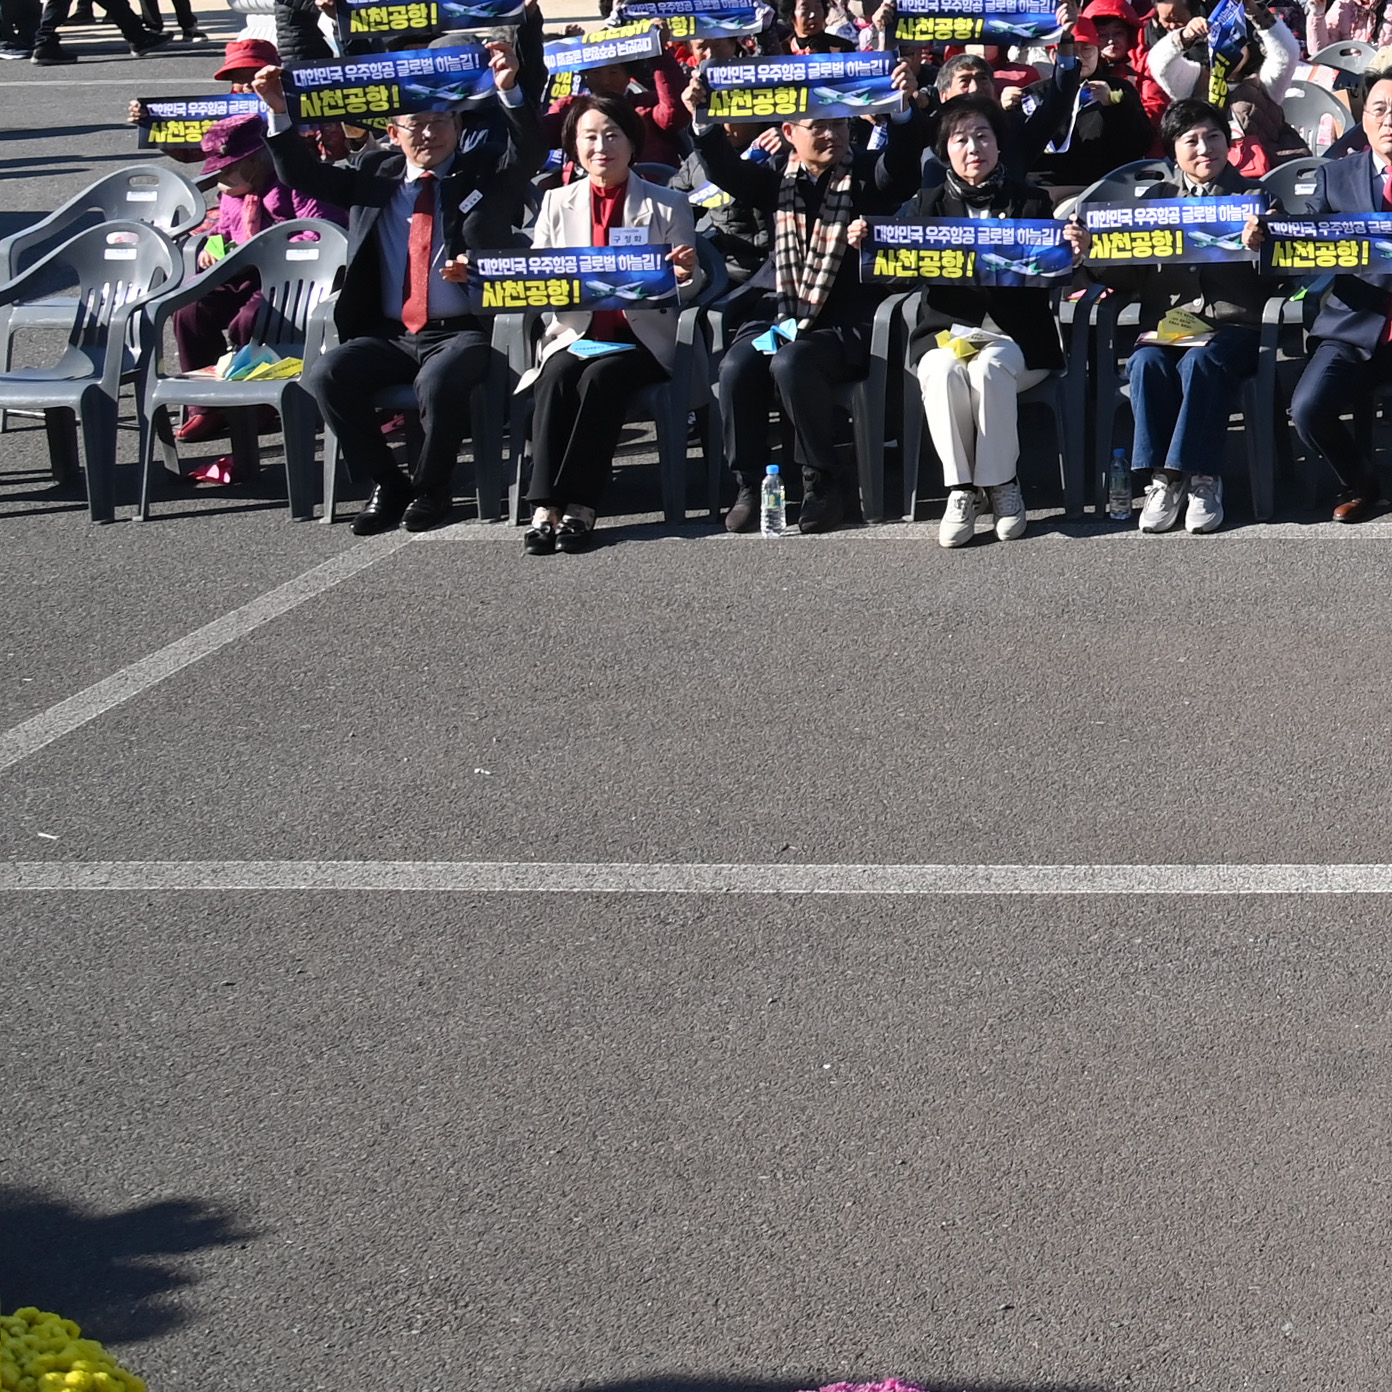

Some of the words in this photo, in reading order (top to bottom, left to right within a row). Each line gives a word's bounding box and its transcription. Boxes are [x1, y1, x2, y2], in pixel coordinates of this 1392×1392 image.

[350, 3, 438, 33] 사천공항!
[896, 18, 983, 41] 사천공항!
[293, 65, 342, 85] 대한민국
[345, 60, 393, 81] 우주항공
[396, 57, 432, 76] 글로벌
[435, 52, 479, 72] 하늘길!
[708, 64, 755, 83] 대한민국
[758, 63, 805, 81] 우주항공
[808, 61, 843, 79] 글로벌
[845, 60, 889, 77] 하늘길!
[300, 86, 399, 117] 사천공항!
[709, 87, 807, 118] 사천공항!
[1087, 210, 1132, 228] 대한민국
[1135, 208, 1179, 226] 우주항공
[1182, 206, 1216, 224] 글로벌
[1218, 204, 1259, 223] 하늘길!
[1268, 222, 1315, 236] 대한민국
[1318, 222, 1365, 235] 우주항공
[874, 225, 922, 243] 대한민국
[925, 226, 974, 244] 우주항공
[977, 226, 1013, 244] 글로벌
[1015, 227, 1060, 245] 하늘길!
[1090, 231, 1183, 259] 사천공항!
[478, 257, 525, 275] 대한민국
[528, 256, 576, 274] 우주항공
[579, 255, 614, 273] 글로벌
[617, 254, 661, 272] 하늘길!
[874, 251, 975, 277] 사천공항!
[1272, 240, 1369, 268] 사천공항!
[482, 279, 580, 307] 사천공항!
